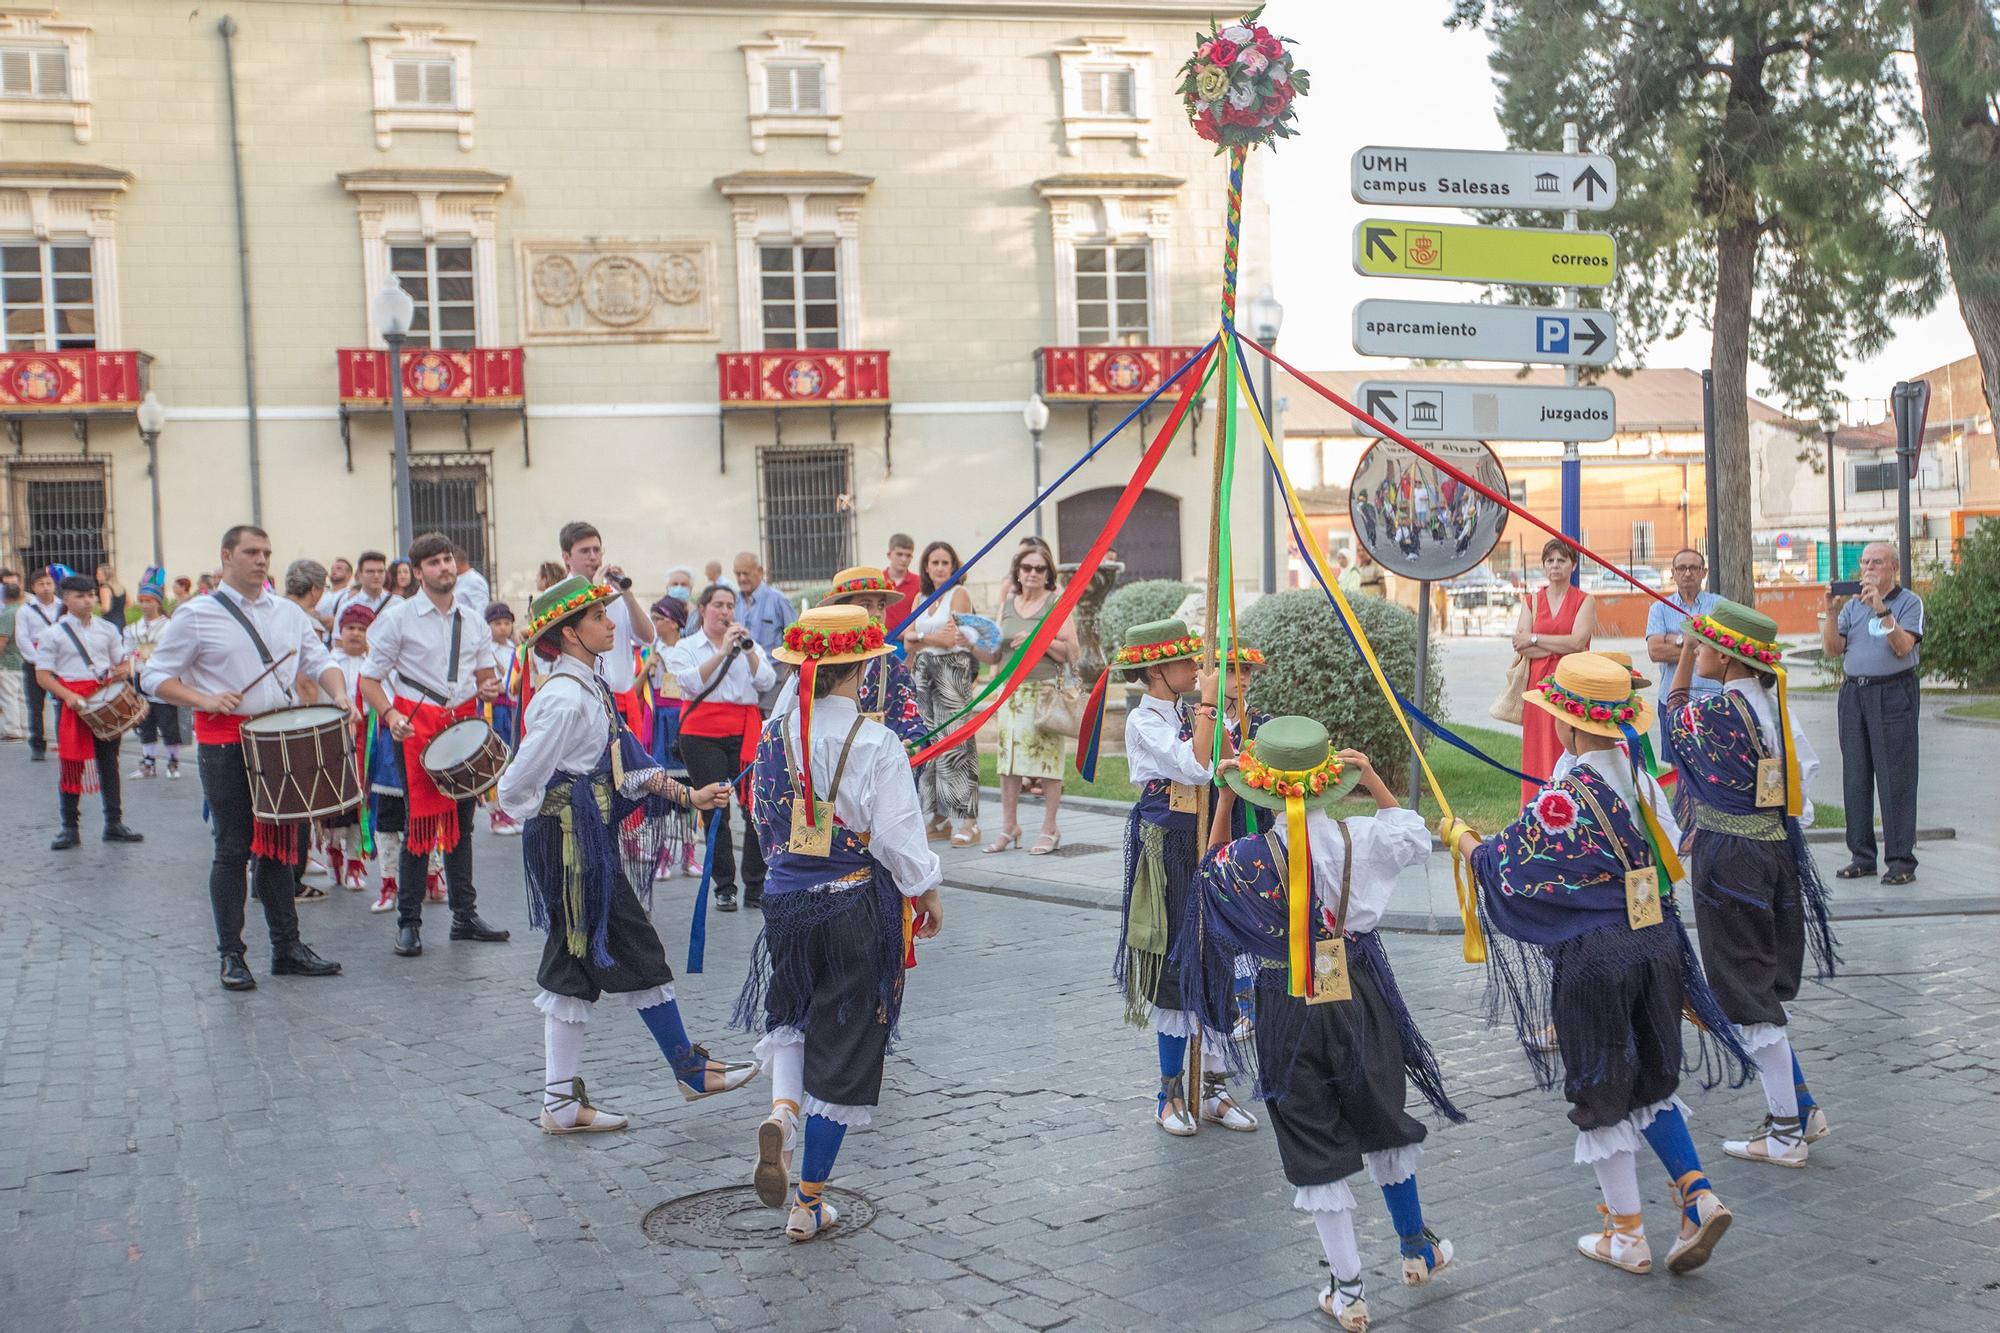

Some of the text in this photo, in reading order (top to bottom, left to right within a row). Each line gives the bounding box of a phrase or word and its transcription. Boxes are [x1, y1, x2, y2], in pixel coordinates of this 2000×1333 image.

[1362, 156, 1408, 172] UMH
[1363, 178, 1511, 195] campus Salesas
[1552, 253, 1609, 267] correos
[1366, 321, 1477, 337] aparcamiento
[1542, 319, 1566, 352] P
[1540, 405, 1609, 422] juzgados
